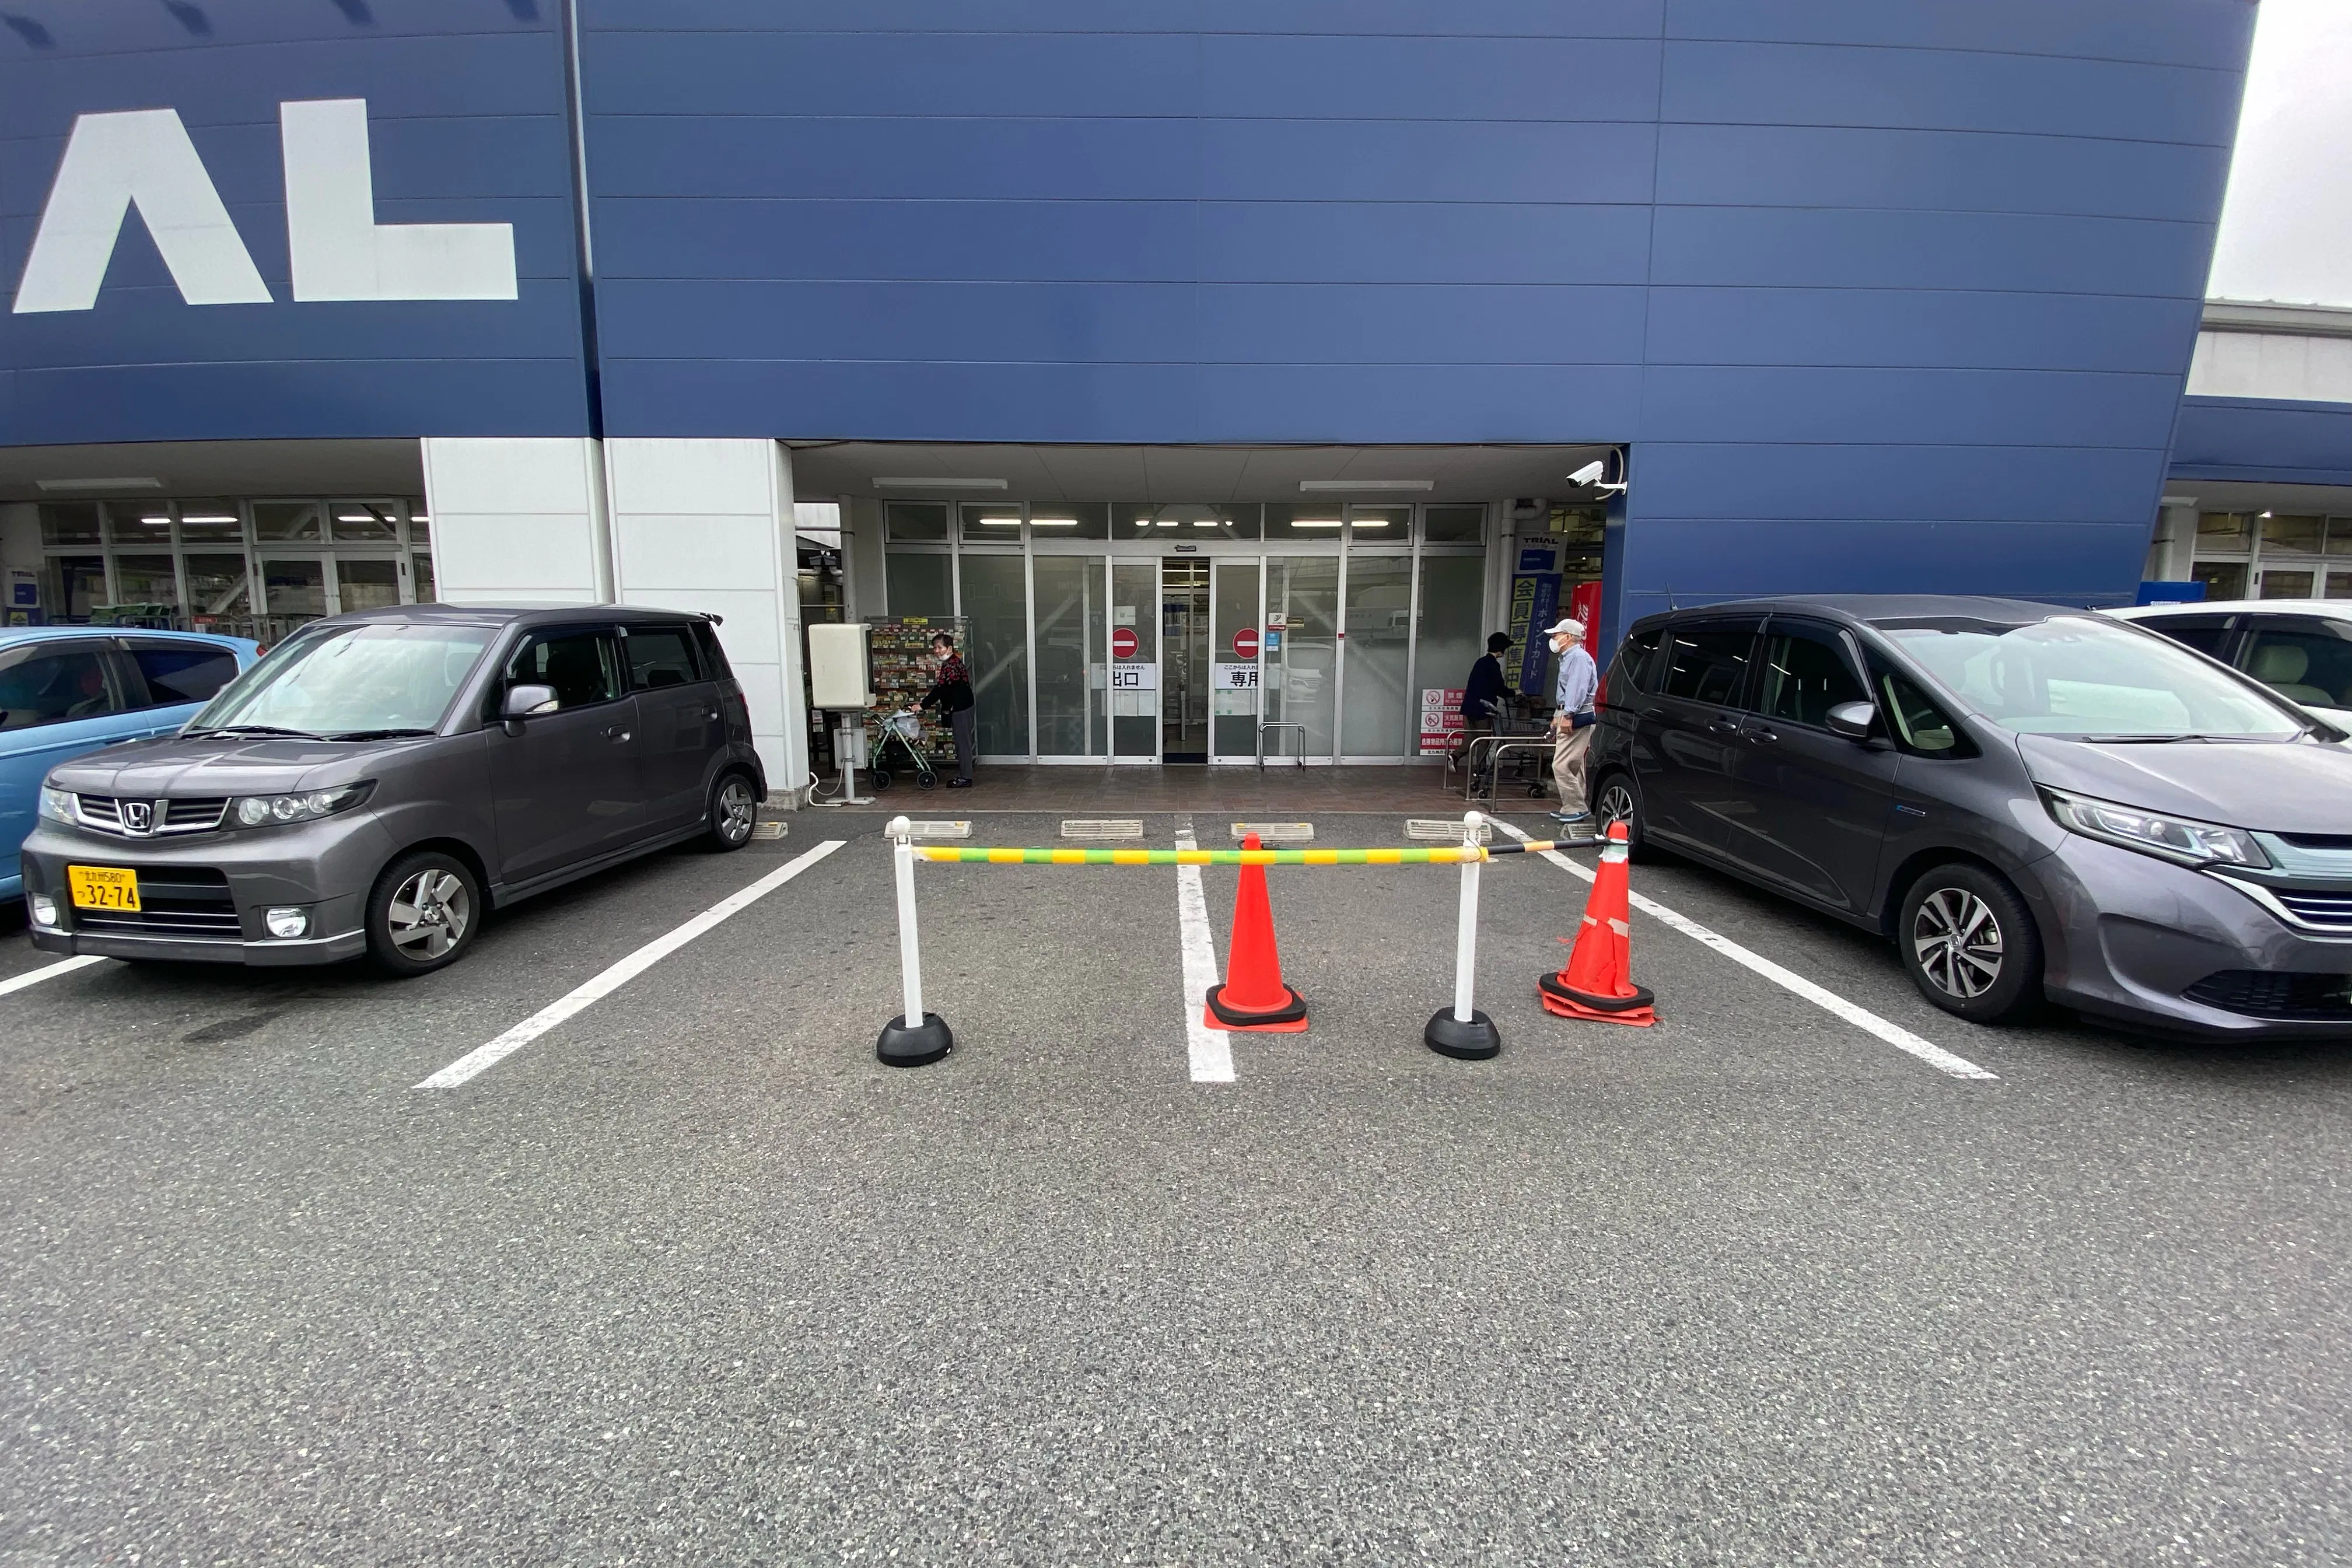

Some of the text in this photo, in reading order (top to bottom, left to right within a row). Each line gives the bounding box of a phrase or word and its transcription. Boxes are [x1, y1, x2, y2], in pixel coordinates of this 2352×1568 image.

[13, 98, 518, 313] AL
[1506, 579, 1534, 687] 会員募集中
[1230, 671, 1258, 687] 専用
[86, 884, 135, 908] 32-74
